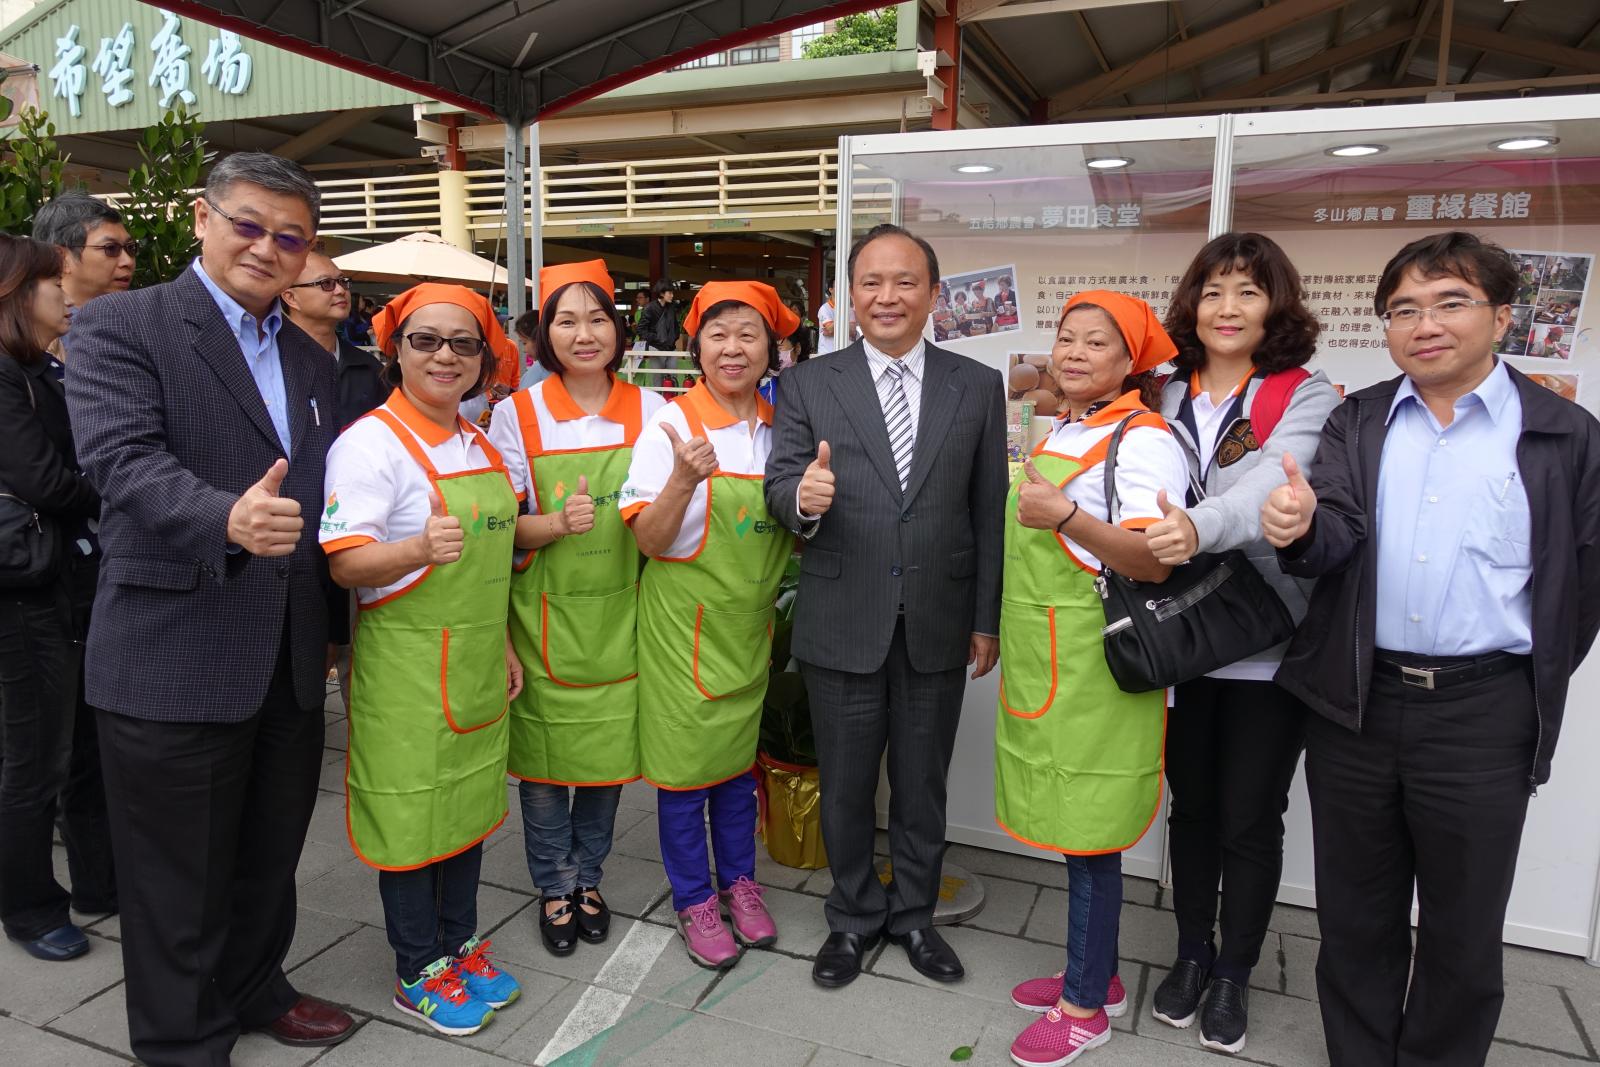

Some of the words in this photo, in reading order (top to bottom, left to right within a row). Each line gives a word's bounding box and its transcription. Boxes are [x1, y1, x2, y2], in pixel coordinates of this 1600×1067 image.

[49, 9, 252, 117] 希望廣場
[1041, 203, 1140, 228] 夢田食堂
[1313, 207, 1396, 222] 冬山鄉農會
